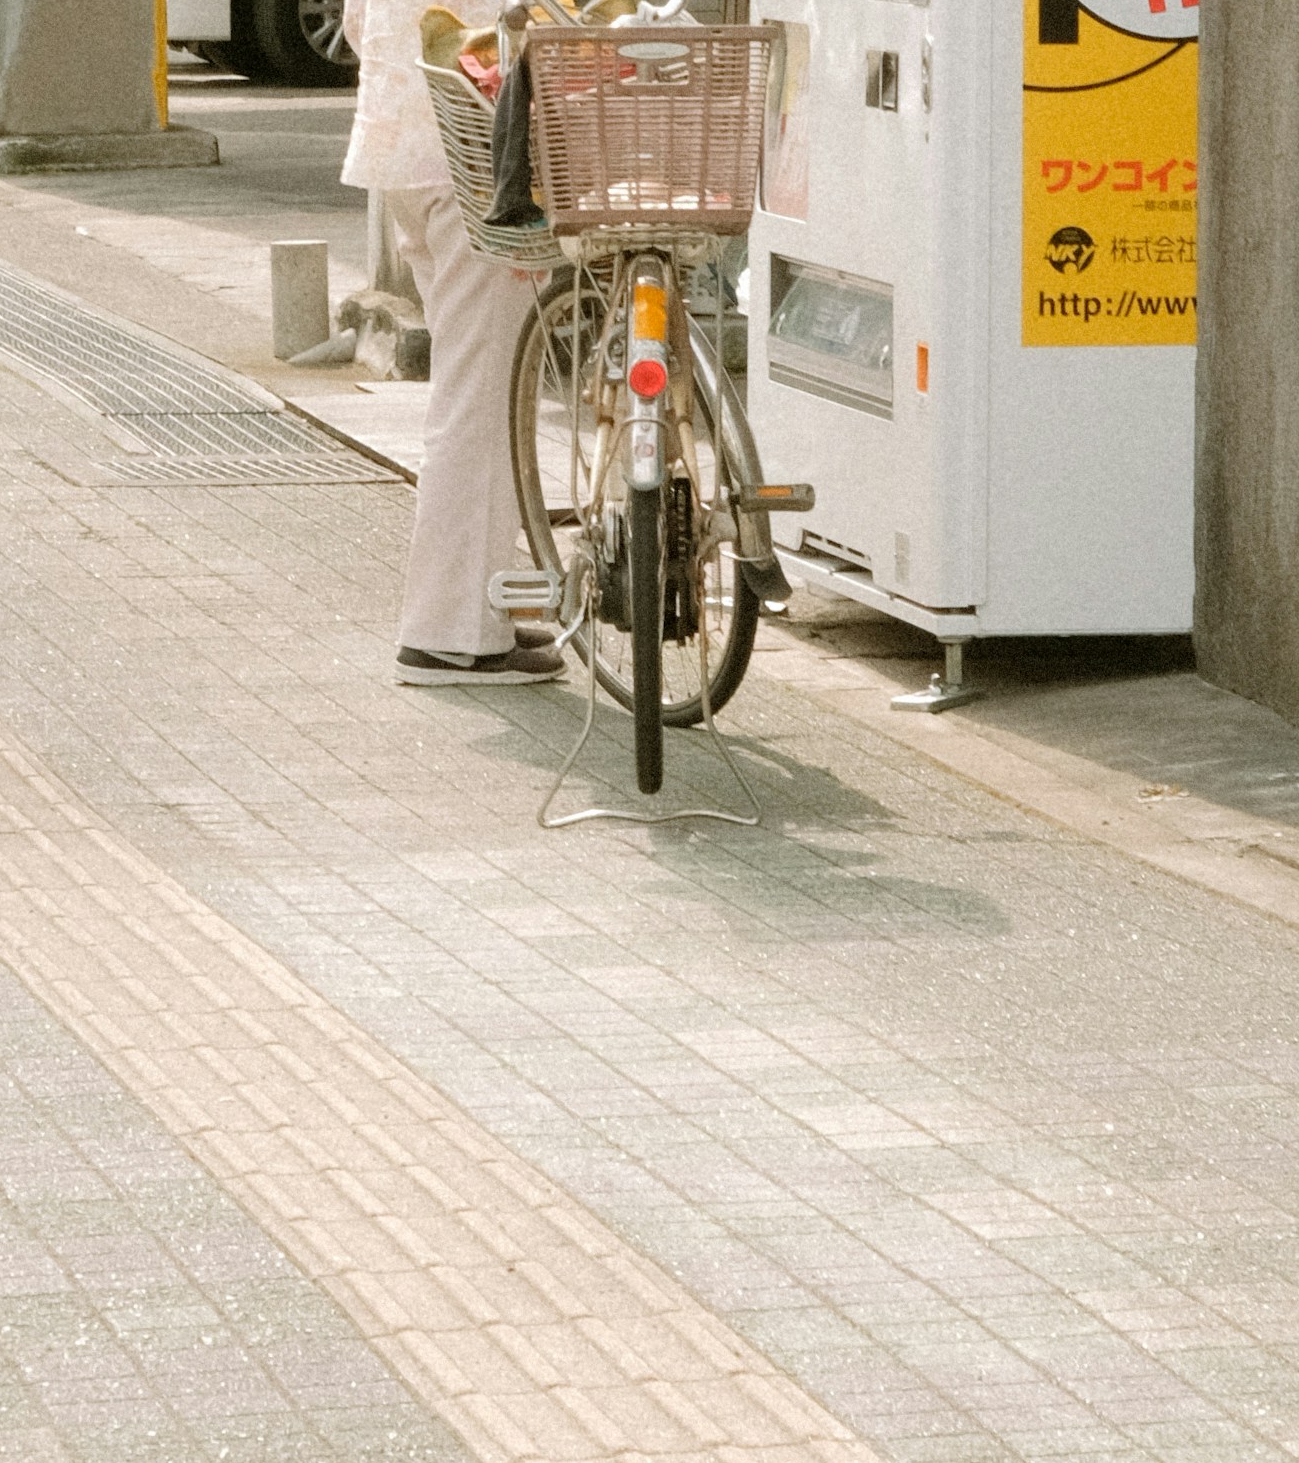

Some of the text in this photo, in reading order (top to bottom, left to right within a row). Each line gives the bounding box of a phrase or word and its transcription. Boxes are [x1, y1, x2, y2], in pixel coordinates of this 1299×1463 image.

[1111, 236, 1197, 263] 株式会社
[1039, 291, 1197, 322] http://ww
